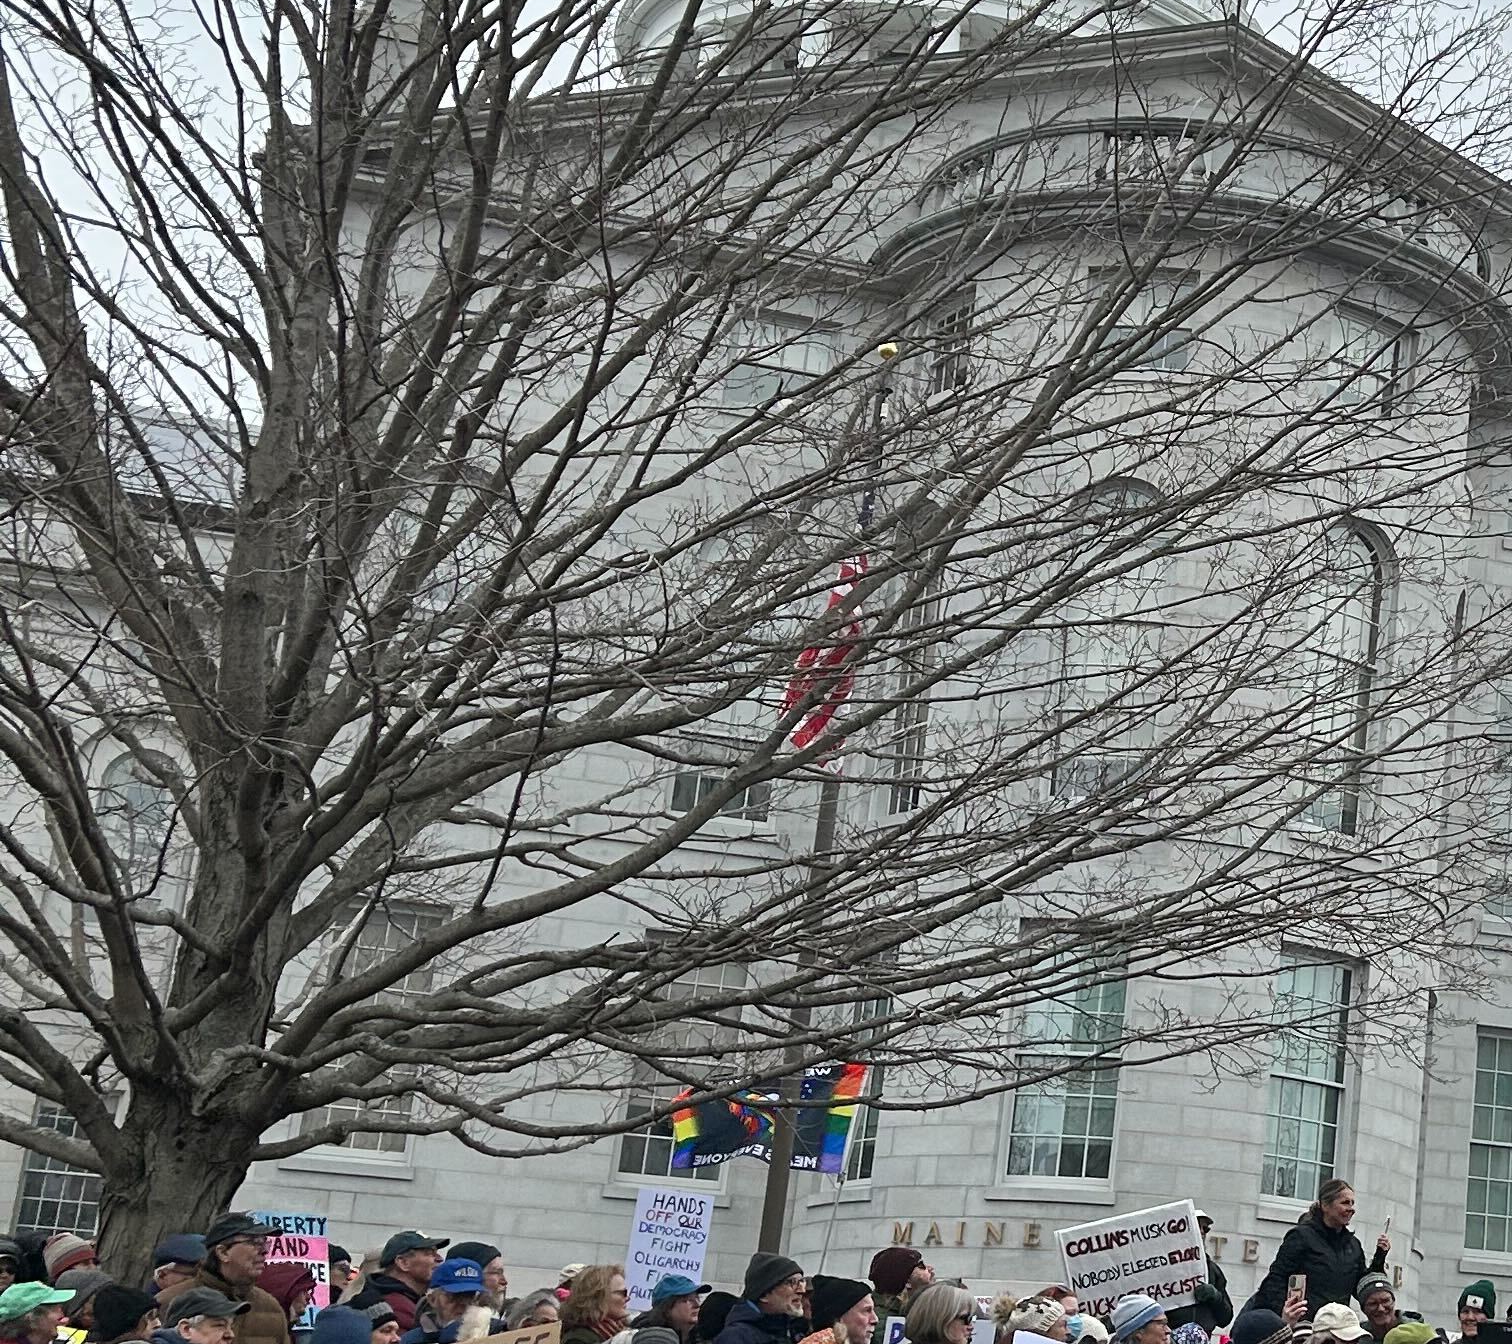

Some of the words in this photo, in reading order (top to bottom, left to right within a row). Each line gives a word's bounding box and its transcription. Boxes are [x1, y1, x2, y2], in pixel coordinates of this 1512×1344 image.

[652, 1193, 706, 1216] HANDS
[264, 1216, 328, 1236] IBERTY
[645, 1209, 675, 1223] OFF
[678, 1214, 703, 1230] OUR
[638, 1220, 708, 1244] DEMOCRACY
[891, 1221, 1042, 1248] MAINE
[1065, 1229, 1130, 1257] COLLINS
[1130, 1222, 1166, 1243] MUSK
[271, 1238, 310, 1257] AND
[650, 1237, 691, 1254] FIGHT
[634, 1250, 700, 1272] OLIGARCHY
[1071, 1264, 1121, 1292] NOBODY
[1122, 1255, 1168, 1277] ELECTED
